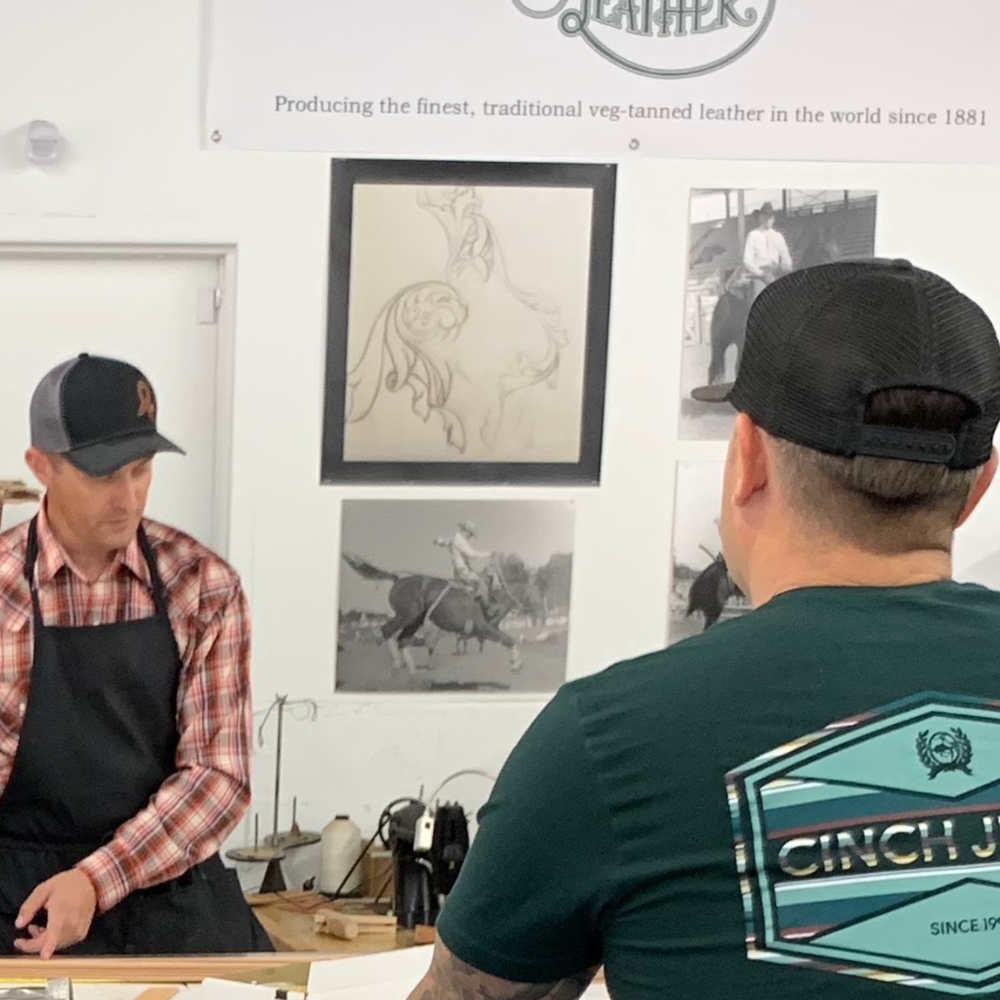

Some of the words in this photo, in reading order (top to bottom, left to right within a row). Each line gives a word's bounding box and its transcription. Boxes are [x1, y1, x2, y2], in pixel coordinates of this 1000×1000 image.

[274, 95, 374, 117] Producing
[379, 97, 410, 114] the
[416, 97, 475, 117] finest,
[482, 99, 582, 117] traditional
[588, 102, 692, 121] veg-tanned
[699, 103, 764, 121] leather
[770, 105, 788, 122] in
[795, 106, 825, 123] the
[830, 107, 881, 124] world
[888, 108, 937, 125] since
[945, 109, 987, 126] 1881
[778, 818, 958, 877] CINCH
[930, 919, 979, 936] SINCE
